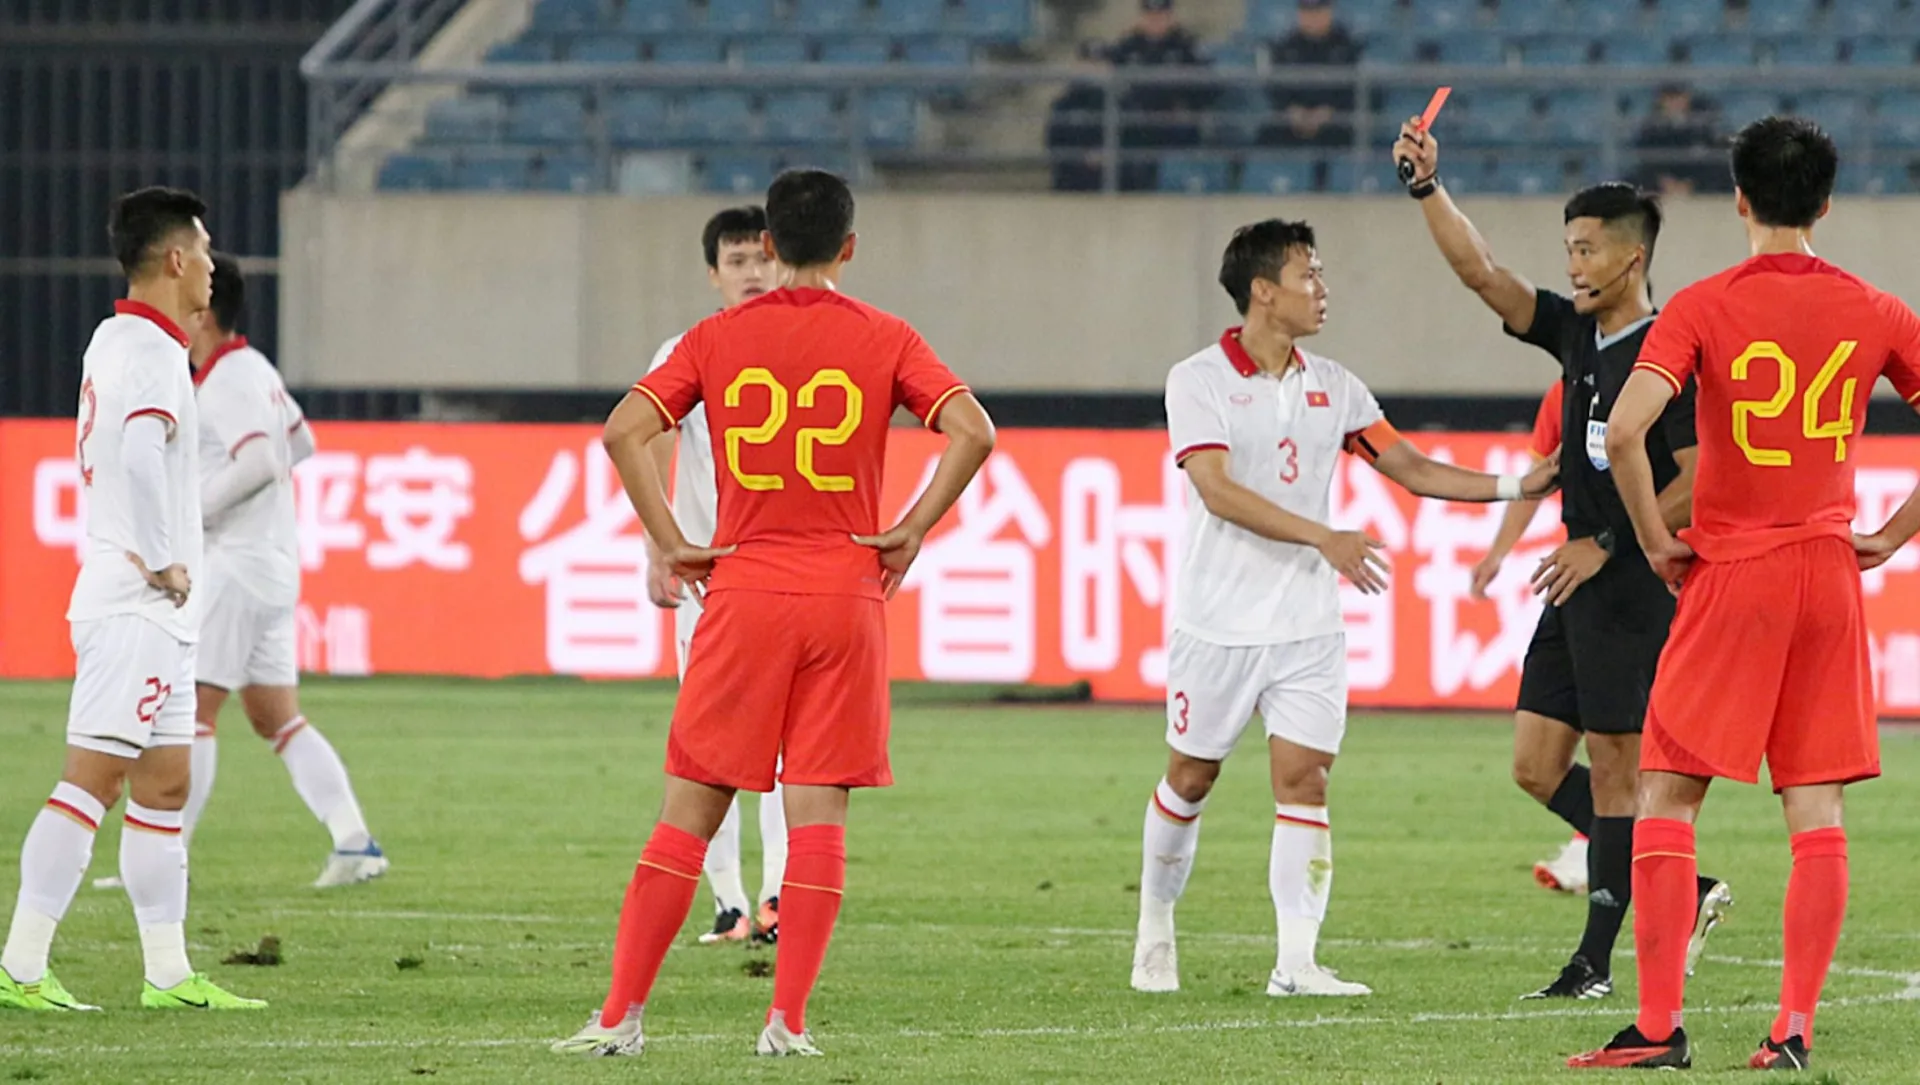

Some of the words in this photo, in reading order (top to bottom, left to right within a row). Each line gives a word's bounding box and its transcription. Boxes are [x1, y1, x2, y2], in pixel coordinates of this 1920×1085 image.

[724, 367, 863, 491] 22
[1731, 340, 1858, 467] 24
[1278, 436, 1299, 484] 3
[1173, 690, 1189, 736] 3
